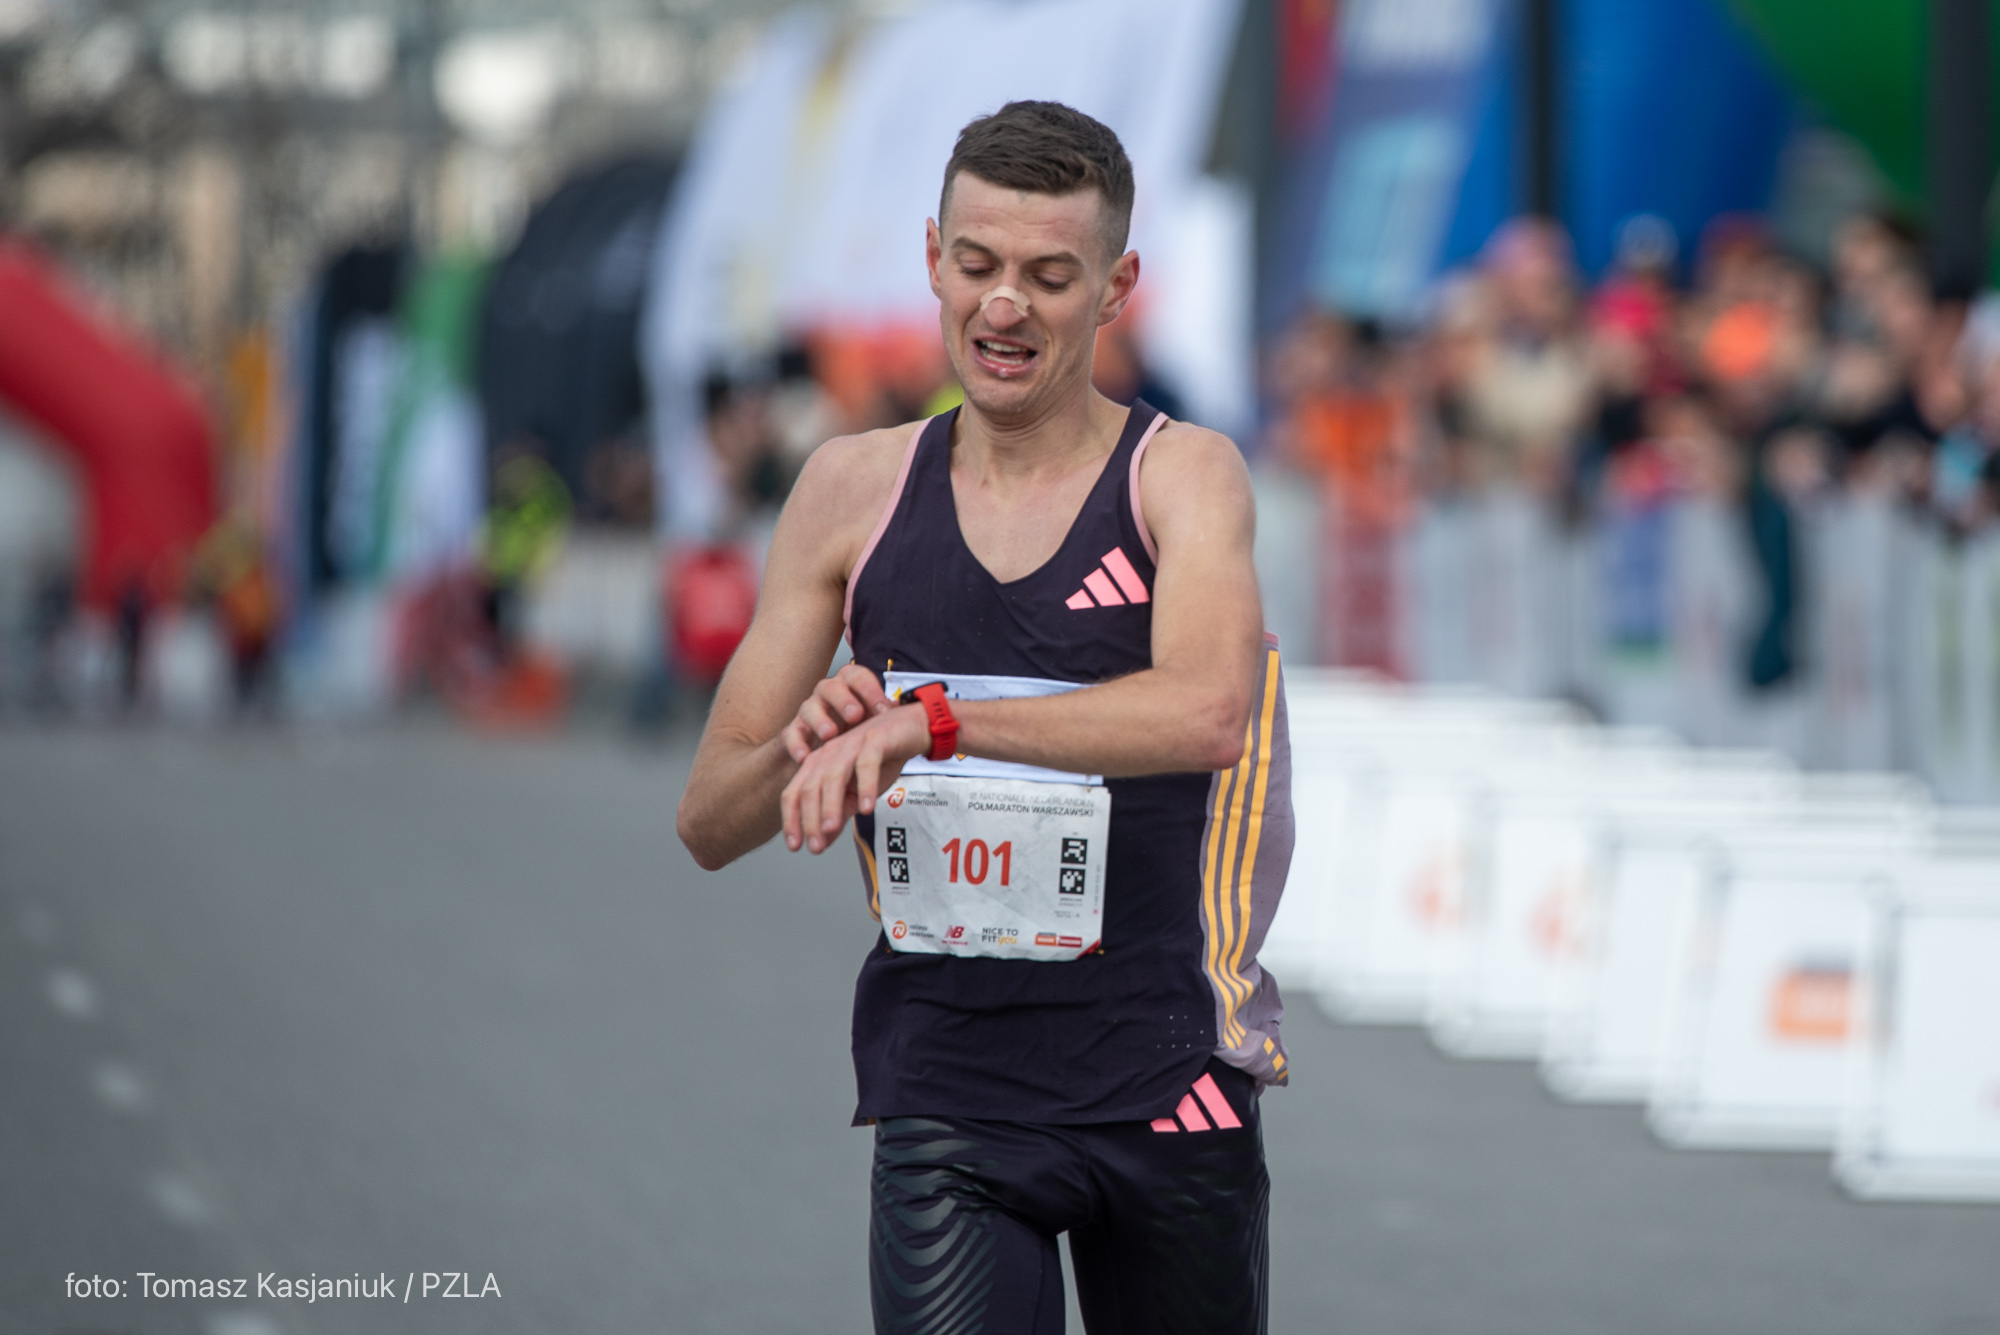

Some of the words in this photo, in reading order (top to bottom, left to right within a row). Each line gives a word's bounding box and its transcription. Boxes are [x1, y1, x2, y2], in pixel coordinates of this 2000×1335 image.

[905, 798, 949, 807] nederlanden
[968, 801, 1029, 813] PÓŁMARATON
[1032, 805, 1094, 818] WARSZAWSKI
[942, 837, 1012, 887] 101
[982, 927, 1004, 936] NICE
[1006, 928, 1019, 937] TO
